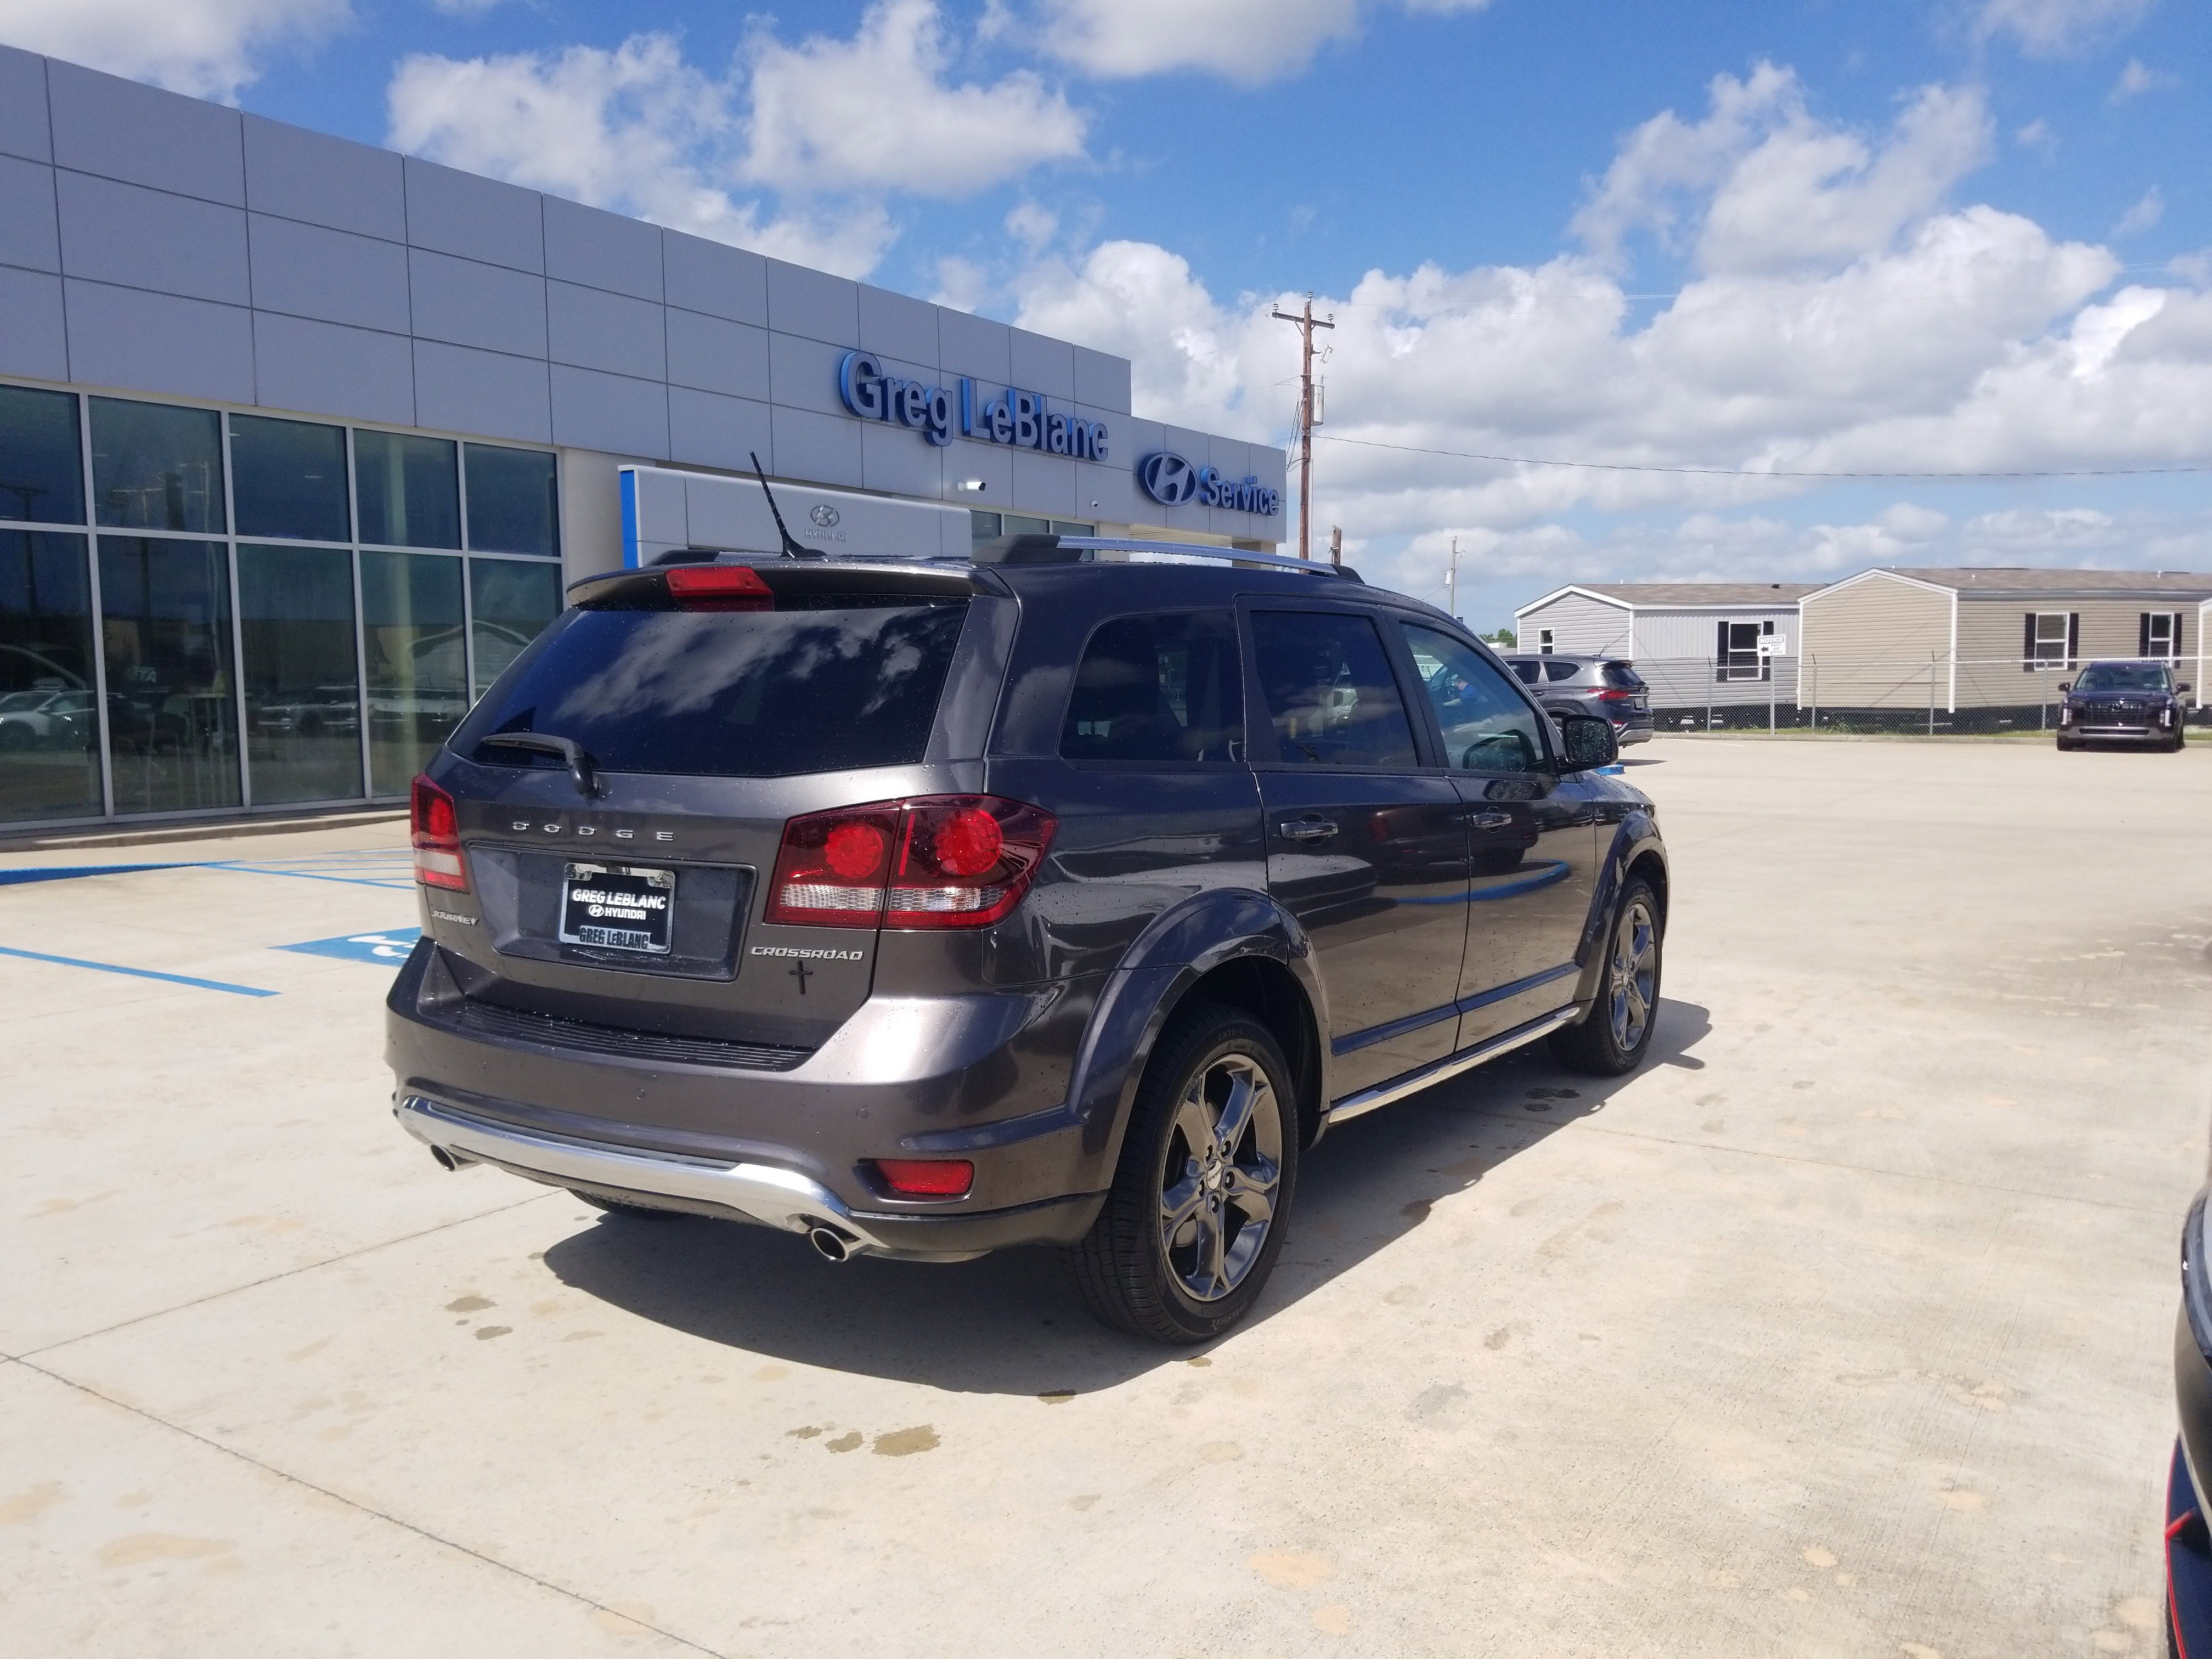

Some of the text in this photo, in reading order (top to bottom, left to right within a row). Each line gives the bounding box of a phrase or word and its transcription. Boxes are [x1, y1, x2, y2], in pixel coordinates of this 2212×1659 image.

[840, 351, 1109, 462] Greg LeBlanc
[1200, 467, 1279, 516] Service
[512, 822, 674, 841] DODGE
[572, 889, 667, 910] GREG LEBLANC
[431, 910, 479, 926] JOURNEY
[605, 907, 646, 920] HYUNDAI
[579, 927, 605, 944] GREG
[751, 946, 864, 960] CROSSROAD
